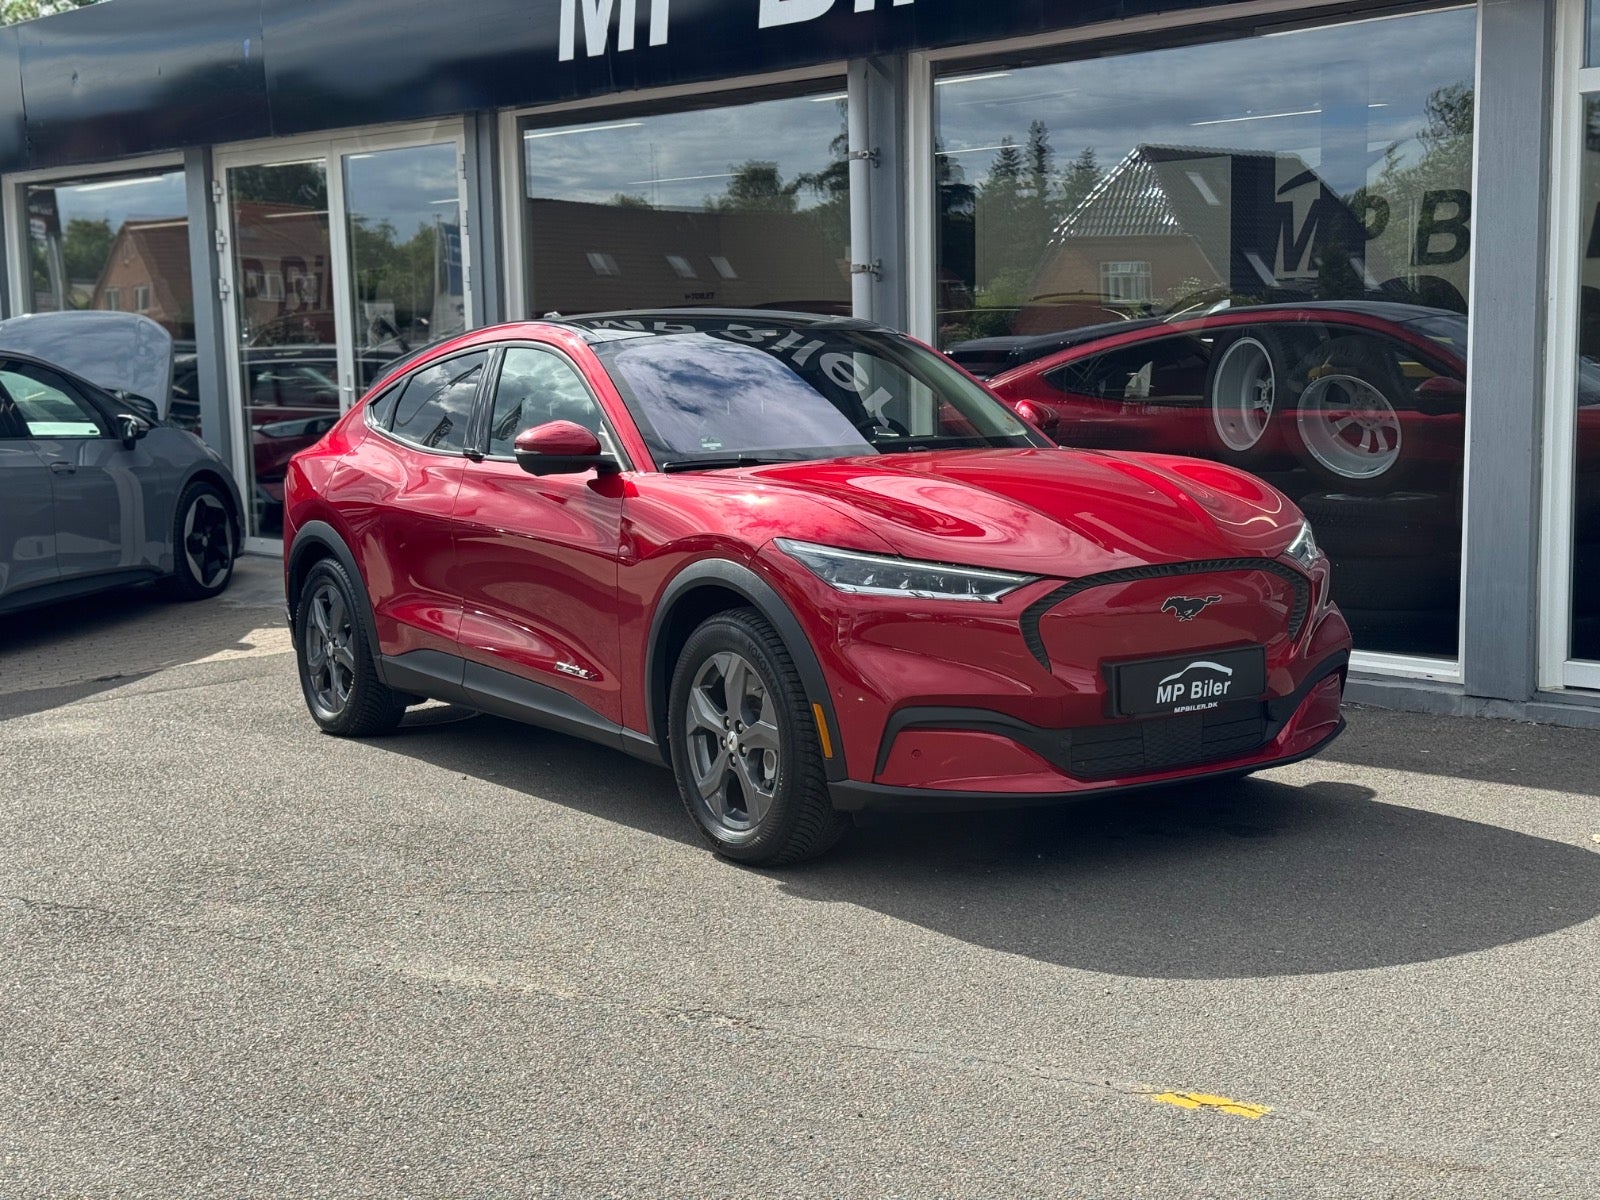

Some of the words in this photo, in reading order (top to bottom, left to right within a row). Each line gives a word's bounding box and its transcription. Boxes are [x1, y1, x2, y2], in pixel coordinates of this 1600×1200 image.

[1156, 683, 1185, 704] MP
[1190, 679, 1231, 699] Biler
[1173, 701, 1218, 713] MPBILER.DK
